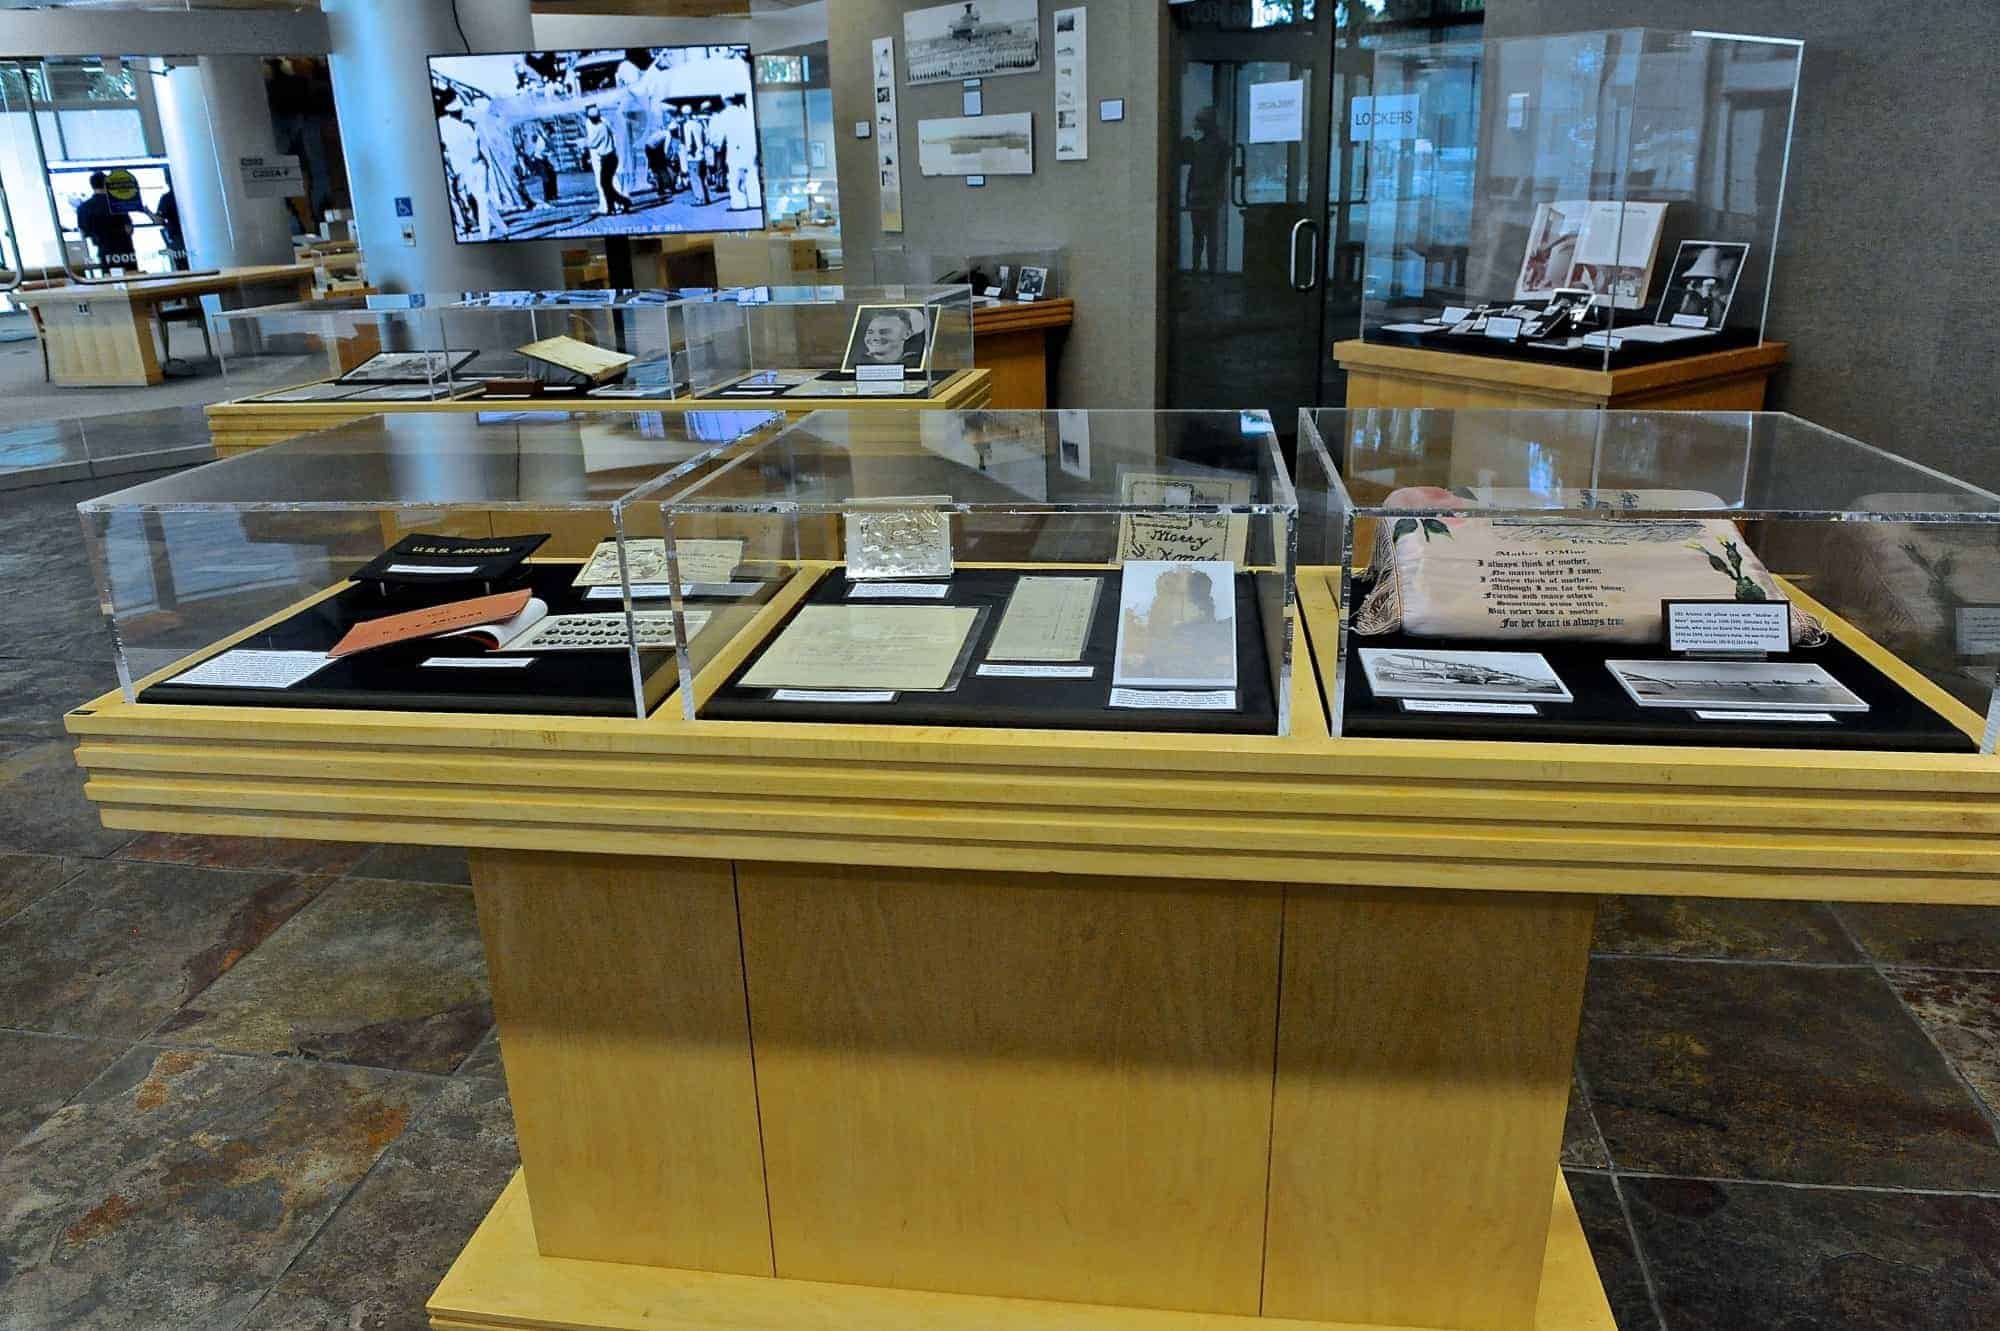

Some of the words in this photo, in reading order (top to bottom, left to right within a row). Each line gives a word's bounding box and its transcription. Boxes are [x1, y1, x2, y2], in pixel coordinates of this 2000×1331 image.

[1355, 110, 1413, 126] LOCKERS
[105, 253, 137, 264] FOOD
[1488, 560, 1518, 568] always
[1521, 559, 1543, 568] think
[1524, 576, 1545, 584] think
[1492, 584, 1532, 592] Although
[1488, 607, 1505, 615] But
[1499, 617, 1518, 628] For
[1521, 618, 1536, 628] her
[1537, 618, 1560, 627] heart
[1562, 618, 1572, 627] is
[1573, 617, 1604, 628] always
